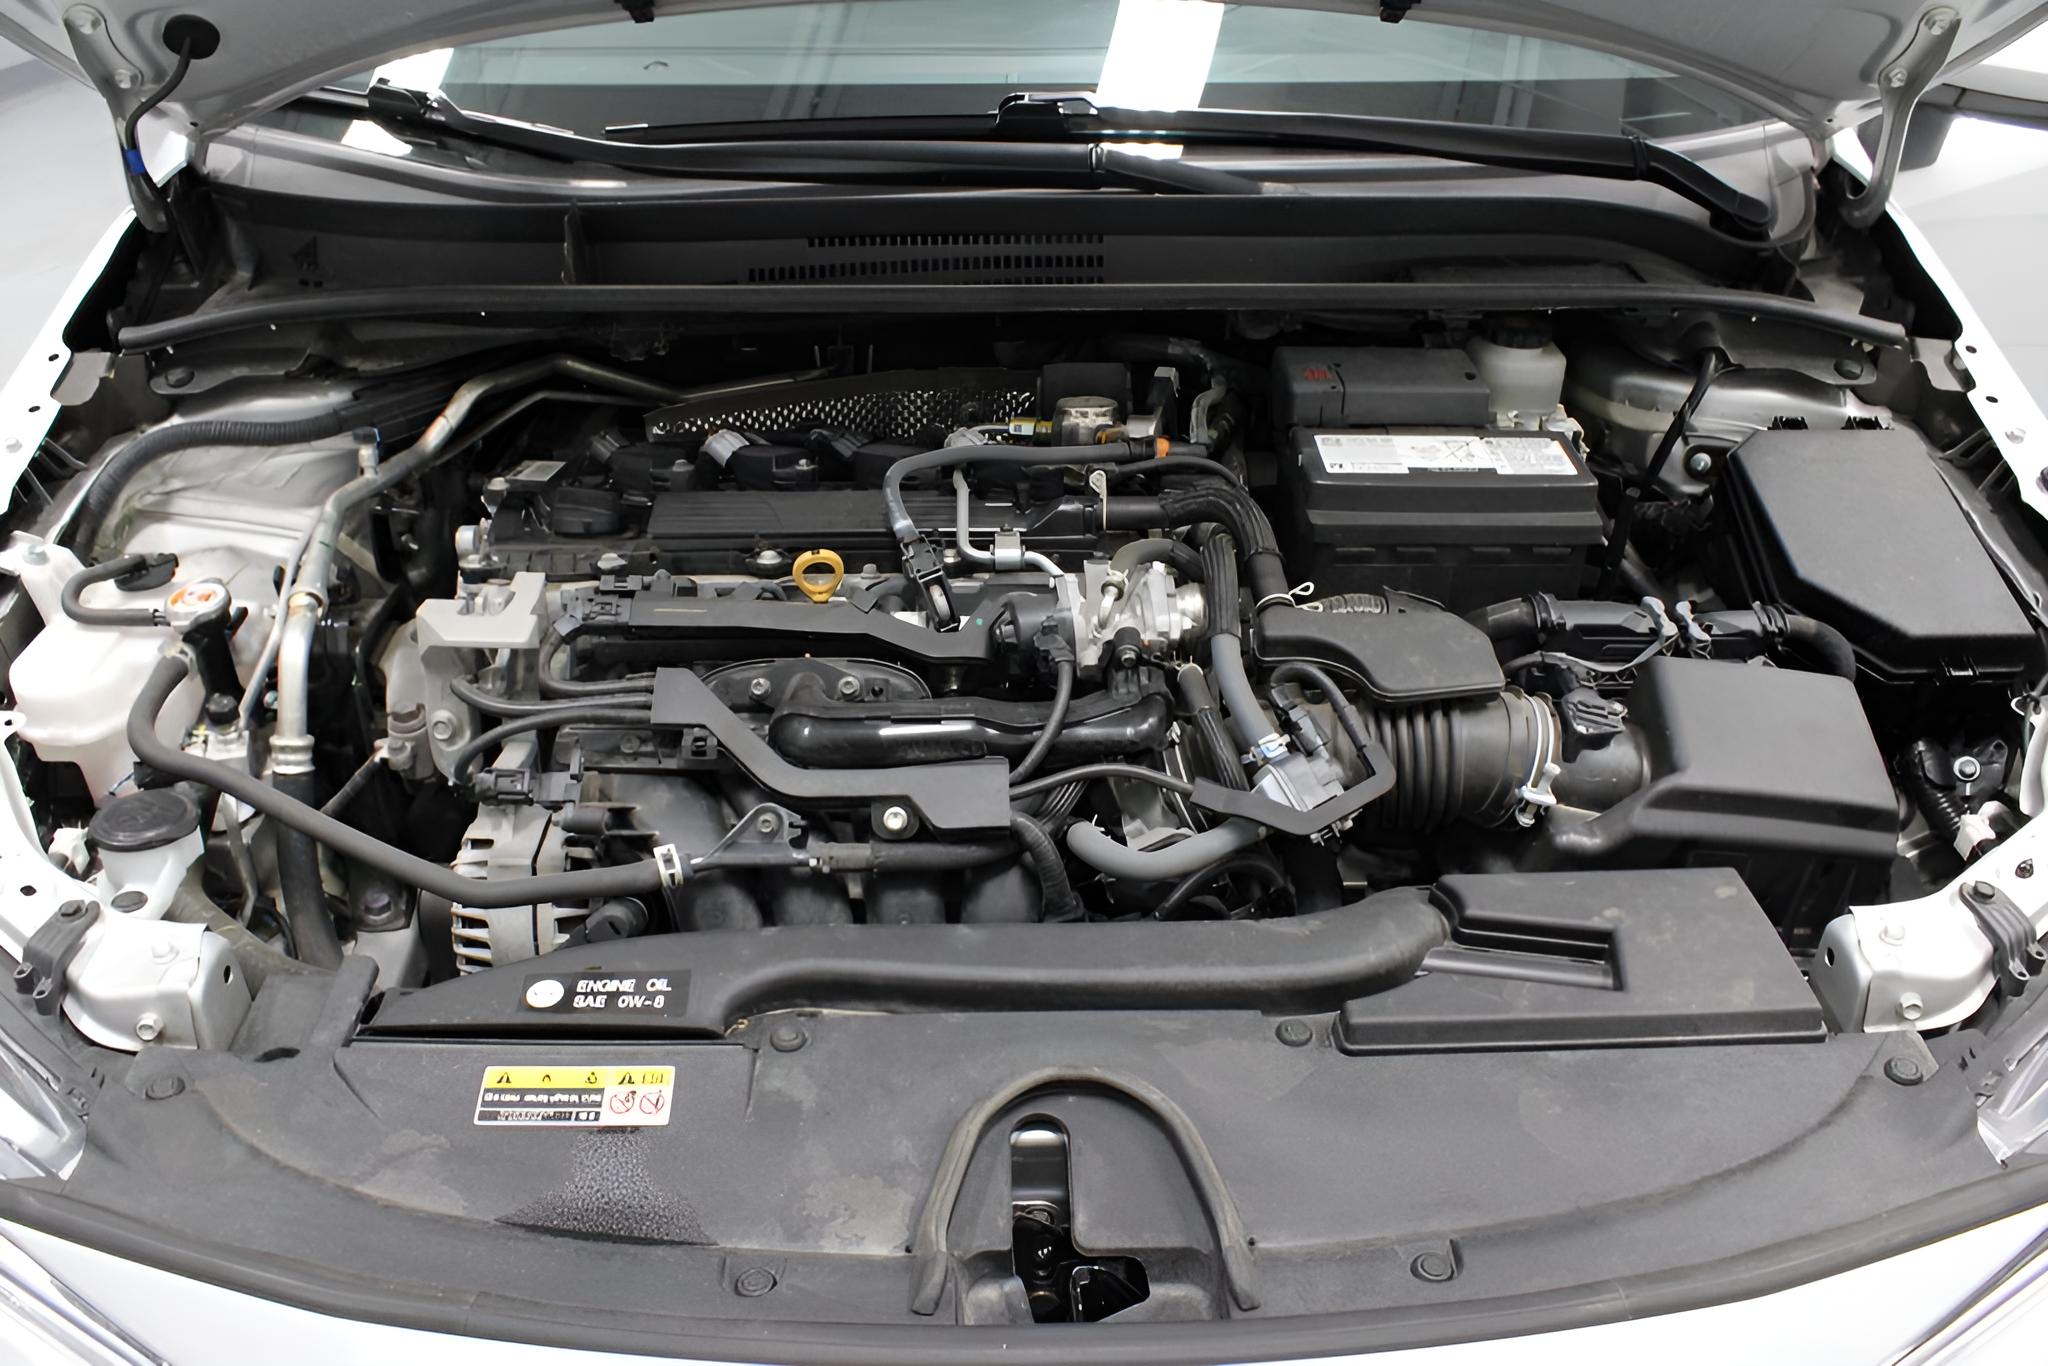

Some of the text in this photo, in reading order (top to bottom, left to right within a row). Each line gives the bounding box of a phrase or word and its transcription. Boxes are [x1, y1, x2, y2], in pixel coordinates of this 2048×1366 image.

[576, 978, 672, 993] ENGINE OIL
[573, 995, 607, 1008] SAE
